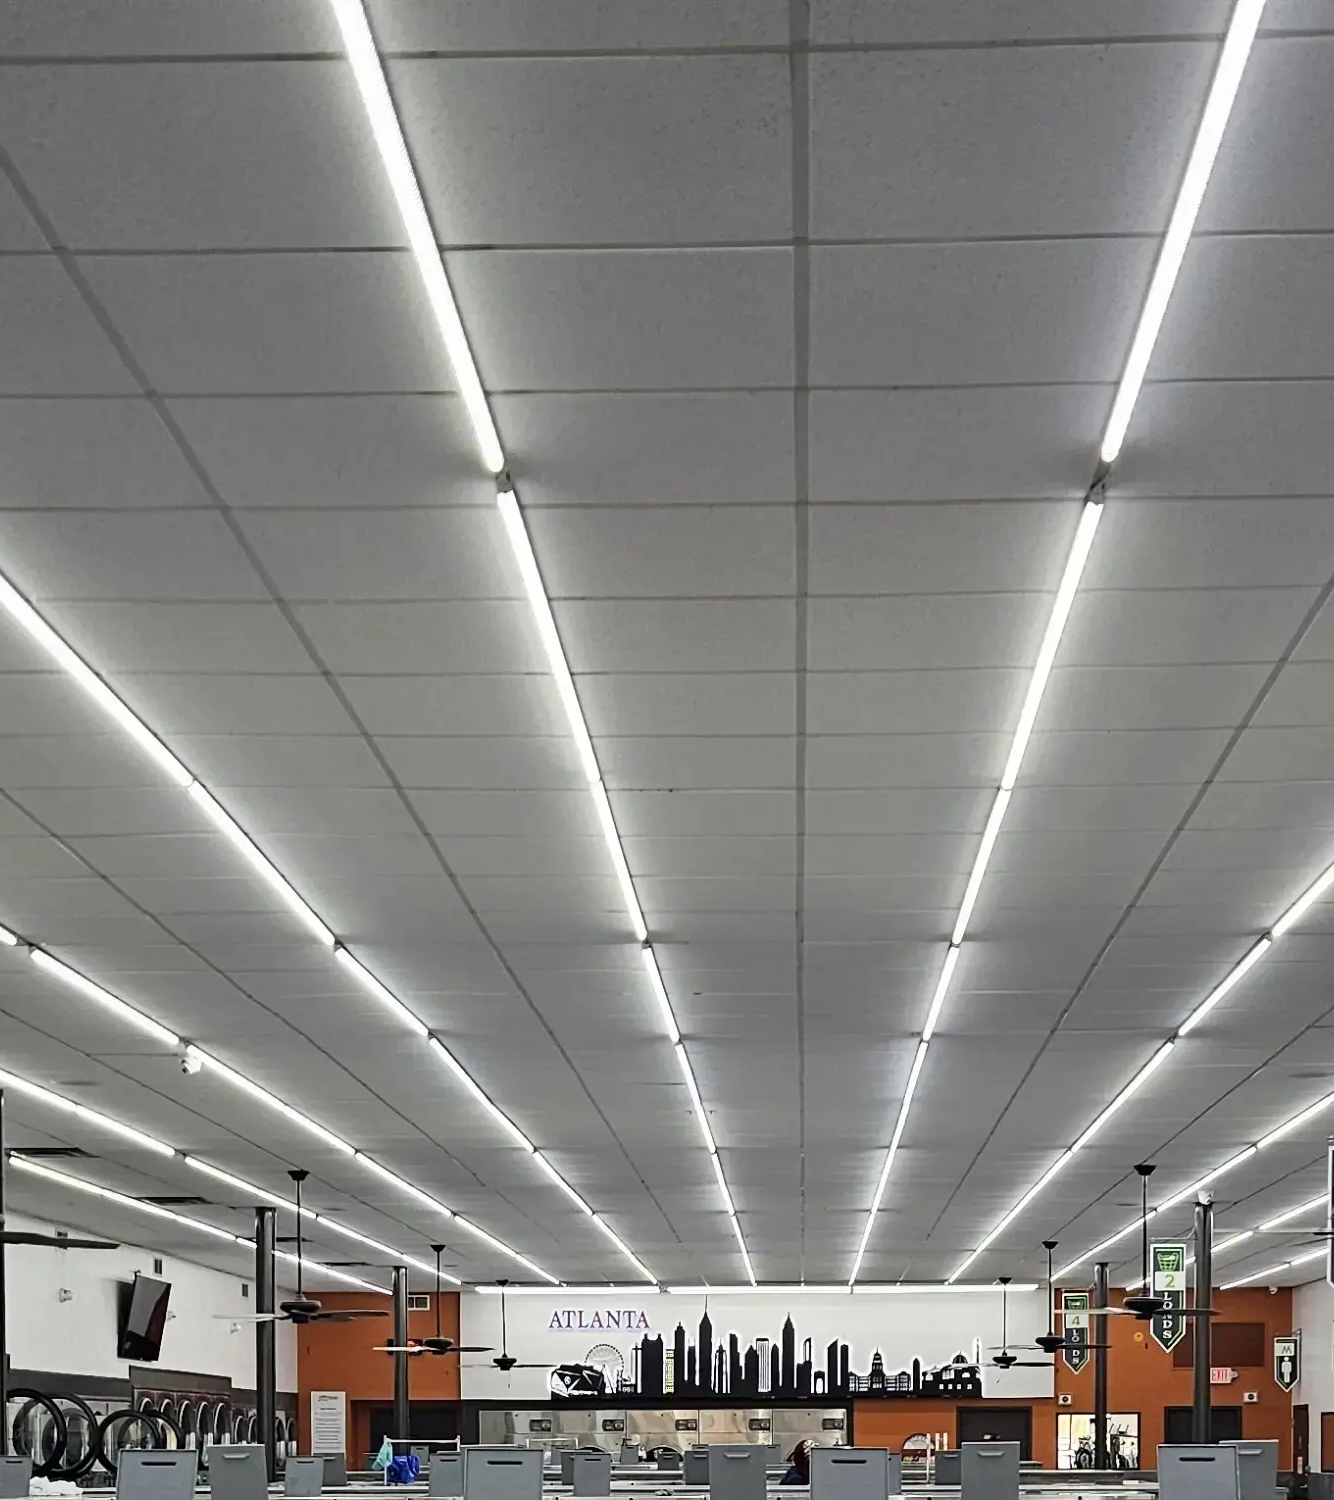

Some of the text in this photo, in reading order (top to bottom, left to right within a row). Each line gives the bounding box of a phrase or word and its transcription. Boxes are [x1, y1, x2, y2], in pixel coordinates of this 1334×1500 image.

[1164, 1274, 1175, 1288] 2
[548, 1310, 652, 1329] ATLANTA
[1071, 1315, 1081, 1326] 4
[1071, 1329, 1081, 1365] LODS
[1281, 1346, 1292, 1354] M
